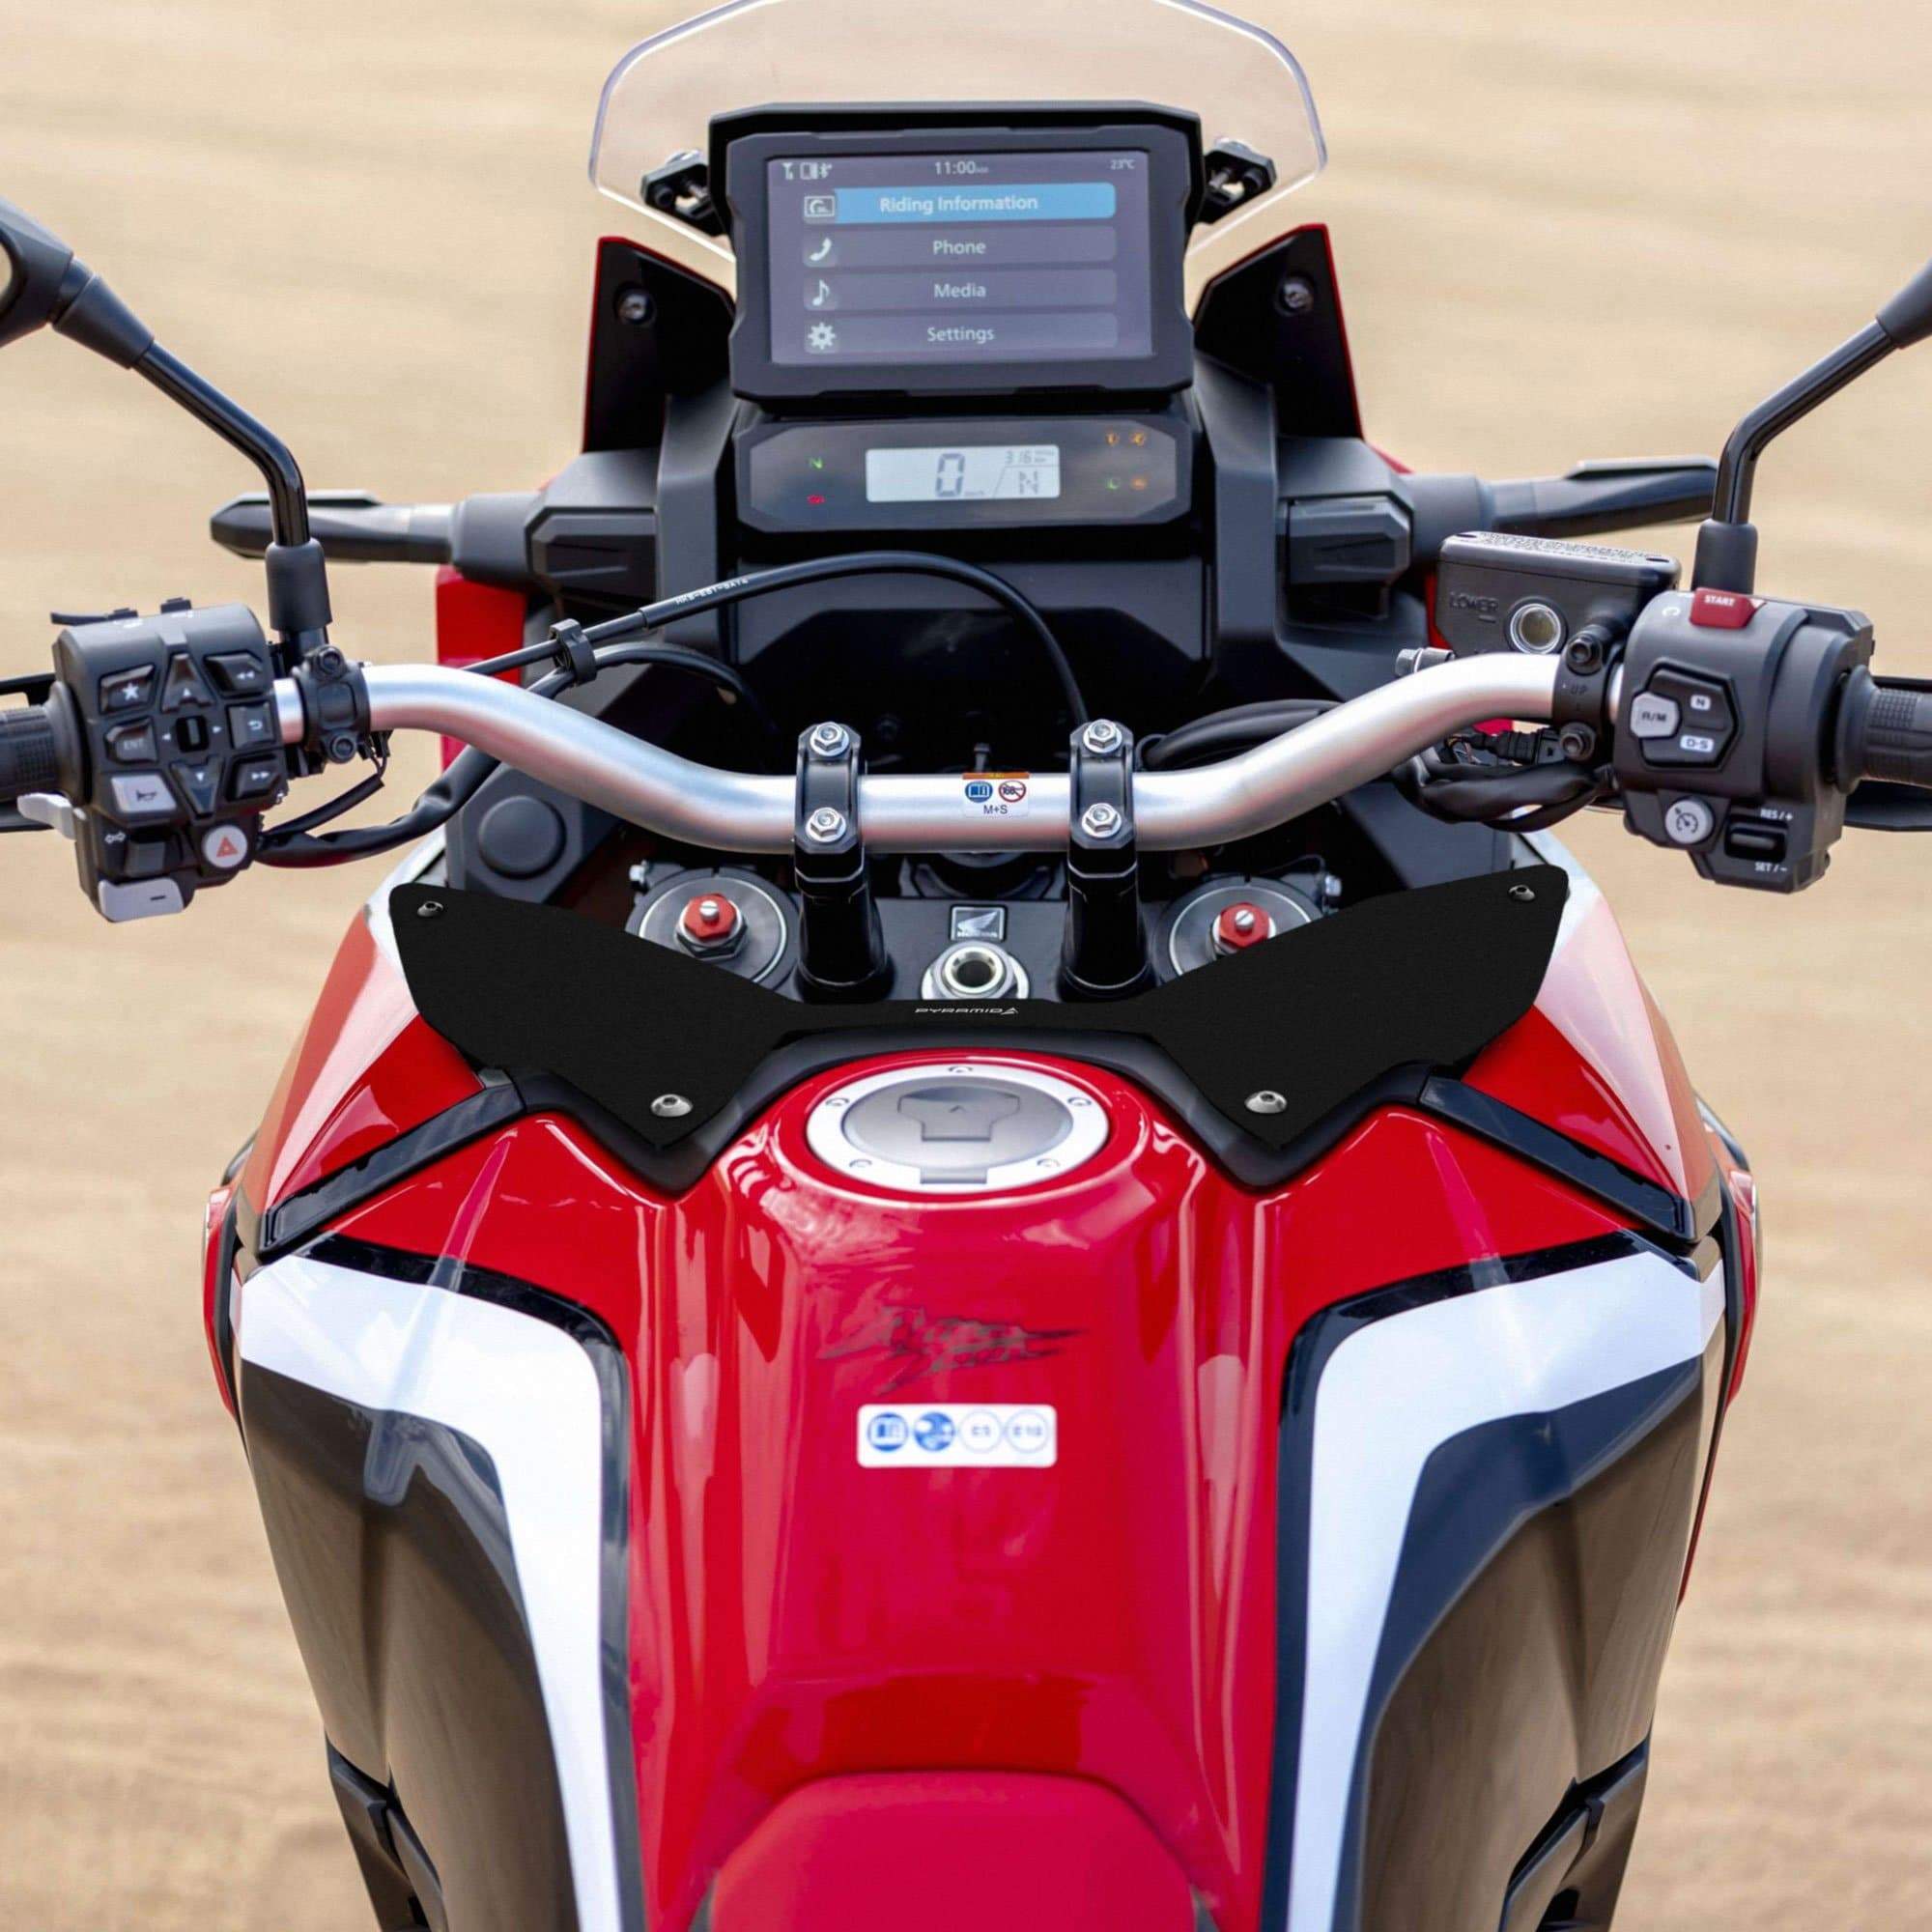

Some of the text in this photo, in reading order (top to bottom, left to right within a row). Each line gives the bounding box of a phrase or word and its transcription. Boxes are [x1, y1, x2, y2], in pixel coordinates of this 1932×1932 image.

[935, 160, 976, 175] 11:00
[880, 194, 1038, 214] Riding Information
[932, 239, 986, 255] Phone
[933, 282, 986, 298] Media
[926, 327, 995, 345] Settings
[934, 452, 965, 498] 0
[1019, 469, 1039, 496] N
[1449, 591, 1498, 611] LOWER
[1704, 593, 1737, 607] START
[1695, 697, 1706, 707] N
[1686, 737, 1710, 751] D-S
[983, 804, 1009, 815] M+S
